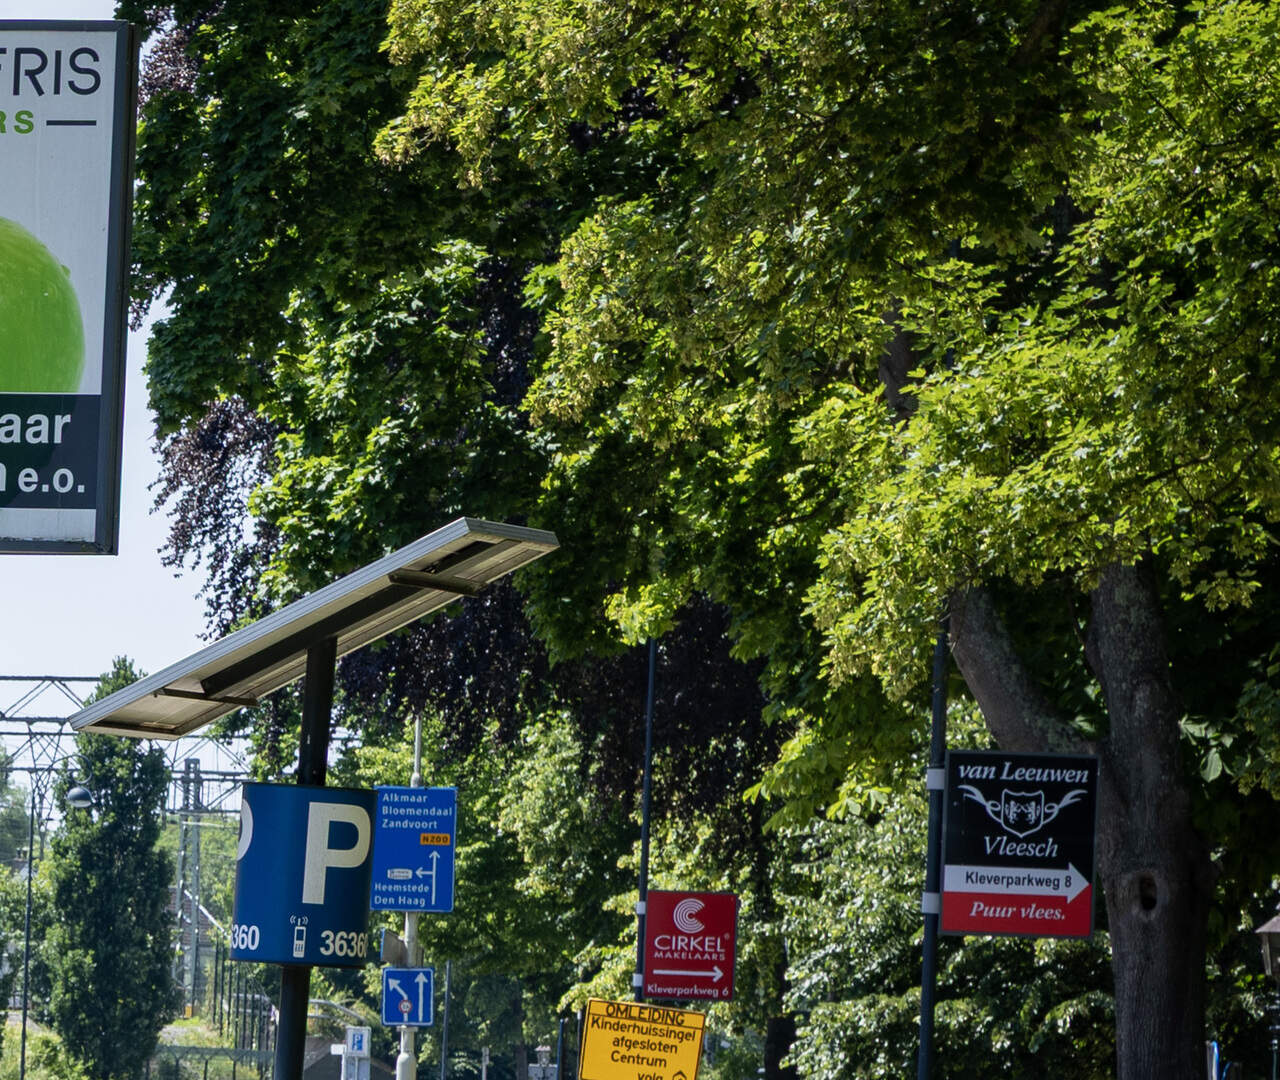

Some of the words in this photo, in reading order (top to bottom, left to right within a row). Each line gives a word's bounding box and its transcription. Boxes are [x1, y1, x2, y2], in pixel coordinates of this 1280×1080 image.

[18, 467, 86, 494] e.o.
[958, 764, 996, 779] van
[1000, 761, 1089, 783] Leeuwen
[382, 793, 428, 803] Alkmaar
[382, 806, 452, 816] Bloemendaal
[382, 819, 438, 829] Zandvoort
[302, 801, 372, 905] P
[984, 836, 1059, 857] Vleesch
[374, 883, 430, 893] Heemstede
[965, 871, 1060, 891] Kleverparkweg
[1064, 875, 1072, 888] 8
[374, 895, 395, 905] Den
[398, 895, 426, 907] Haag
[969, 901, 1016, 919] Puur
[1020, 903, 1065, 920] vlees.
[654, 935, 725, 953] CIRKEL
[654, 951, 726, 961] MAKELAARS
[647, 985, 719, 998] Kleverparkweg
[722, 986, 729, 996] 6
[605, 1004, 685, 1026] OMLEIDING
[590, 1015, 696, 1042] Kinderhuissingel
[612, 1035, 678, 1054] afgesloten
[610, 1050, 667, 1067] Centrum
